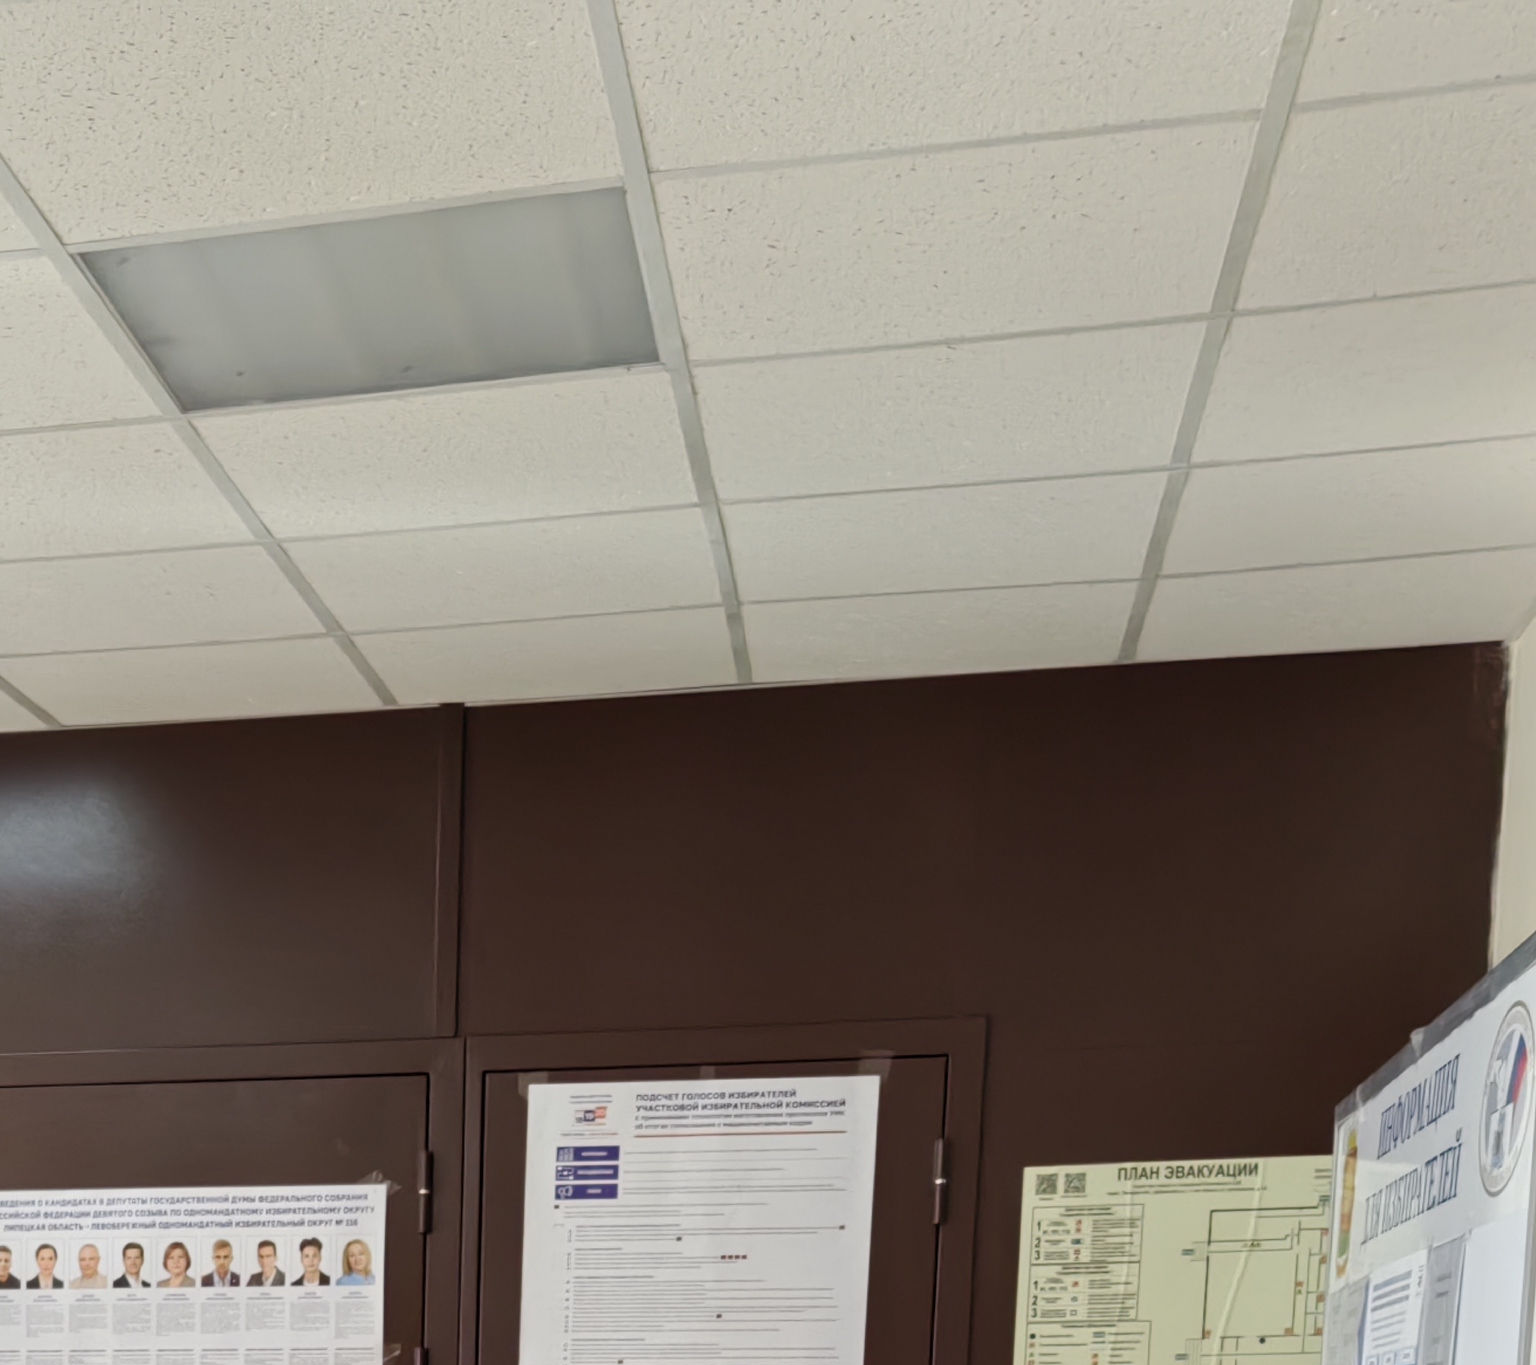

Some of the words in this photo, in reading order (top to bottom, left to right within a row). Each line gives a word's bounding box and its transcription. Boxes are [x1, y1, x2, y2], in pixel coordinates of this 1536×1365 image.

[636, 1093, 679, 1102] ПОДСЧЕТ
[681, 1092, 726, 1100] ГОЛОСОВ
[728, 1089, 796, 1099] ИЗБИРАТЕЛЕЙ
[635, 1101, 699, 1112] УЧАСТКОВОЙ
[701, 1100, 783, 1110] ИЗБИРАТЕЛЬНОЙ
[785, 1098, 846, 1109] КОМИССИЕЙ
[1377, 1053, 1461, 1160] ИНФОРМАЦИЯ
[1117, 1166, 1161, 1182] ПЛАН
[1164, 1162, 1260, 1180] ЭВАКУАЦИИ
[1360, 1188, 1383, 1245] ДЛЯ
[1381, 1128, 1463, 1234] ИЗБИРАТЕЛЕЙ
[149, 1194, 229, 1206] ГОСУДАРСТВЕННОЙ
[258, 1194, 322, 1204] ФЕДЕРАЛЬНОГО
